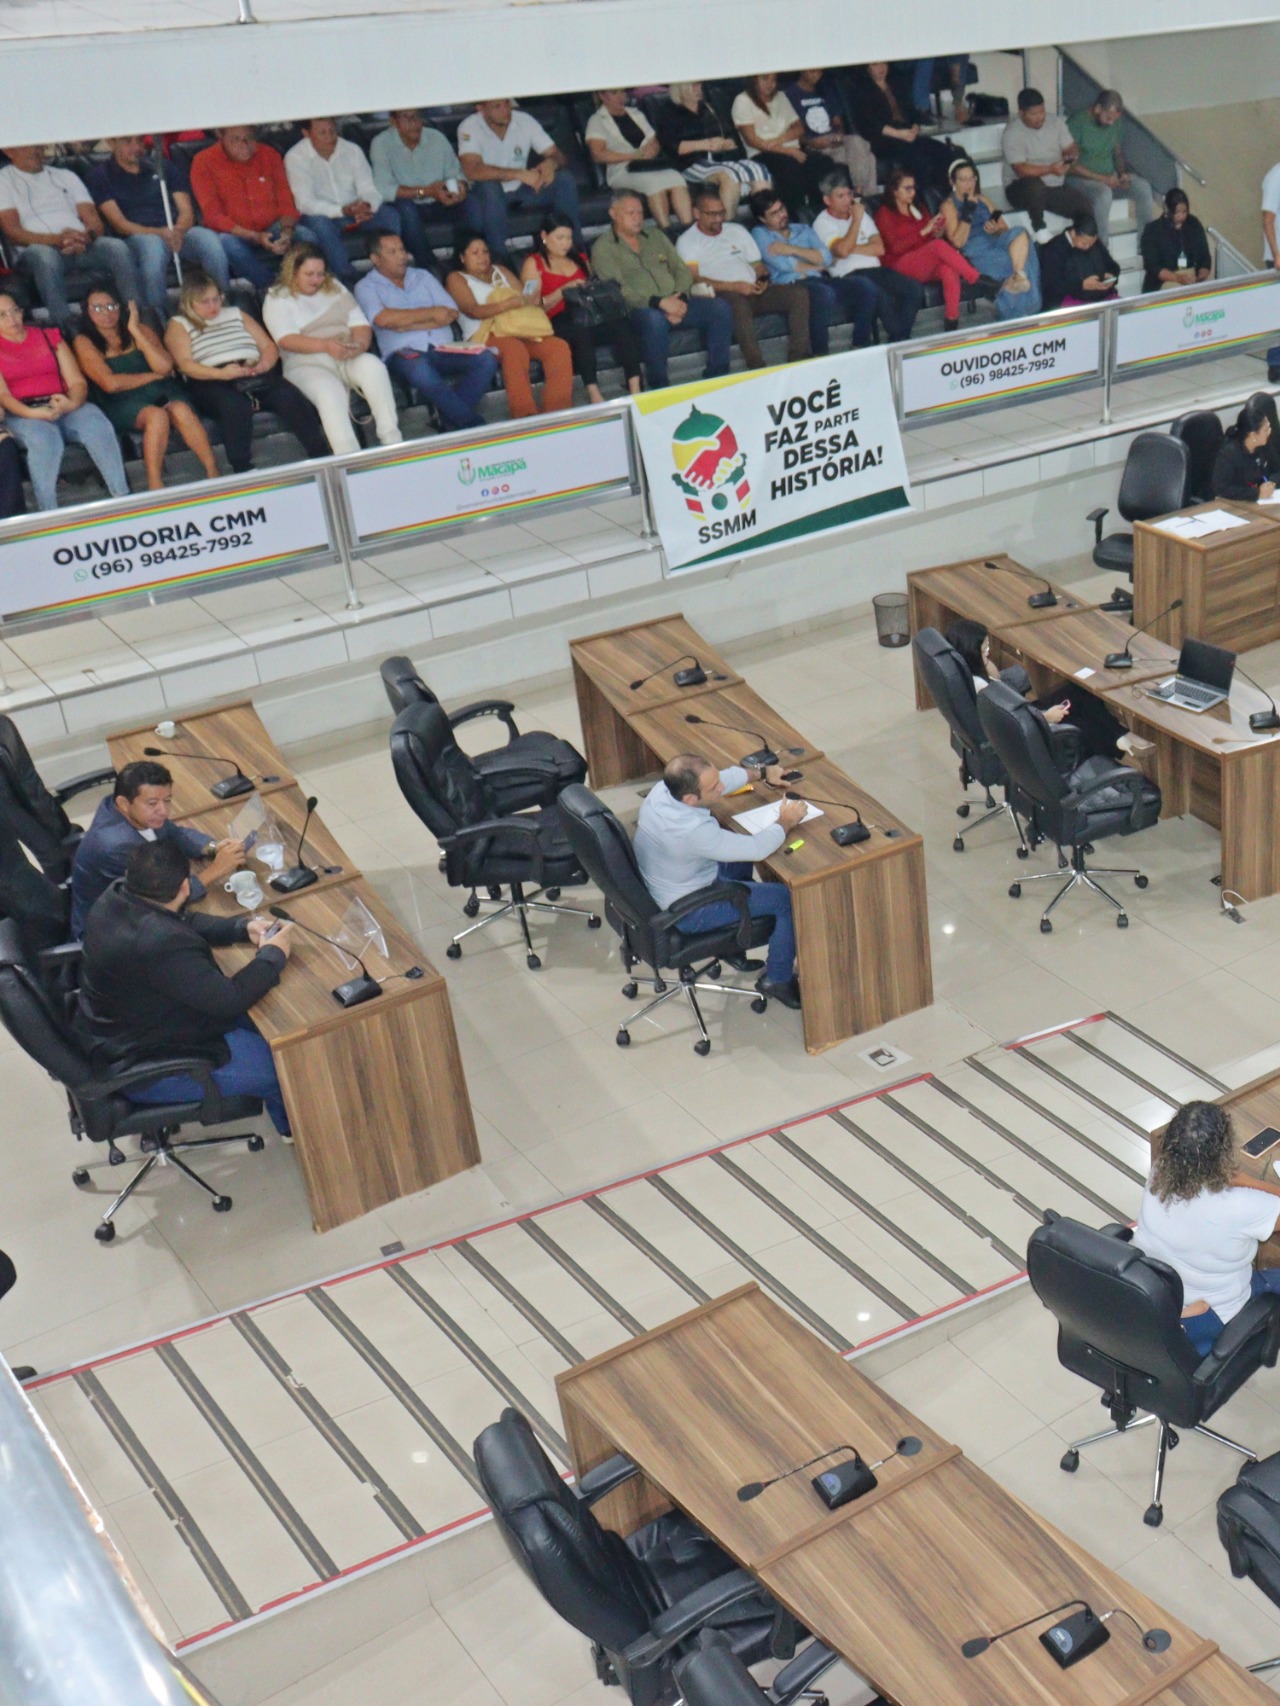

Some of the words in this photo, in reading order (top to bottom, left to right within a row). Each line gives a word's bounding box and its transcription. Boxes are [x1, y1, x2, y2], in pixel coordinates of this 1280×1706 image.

[941, 347, 1027, 376] OUVIDORIA
[1032, 338, 1066, 356] CMM
[960, 373, 985, 388] (96)
[989, 357, 1056, 381] 98425-7992
[766, 378, 842, 426] VOCÊ
[764, 421, 808, 453] FAZ
[814, 408, 860, 433] PARTE
[784, 429, 859, 470] DESSA
[771, 445, 883, 501] HISTÓRIA!
[53, 522, 202, 565] OUVIDORIA
[209, 507, 267, 533] CMM
[698, 508, 757, 544] SSMM
[91, 559, 133, 579] (96)
[140, 532, 253, 567] 98425-7992
